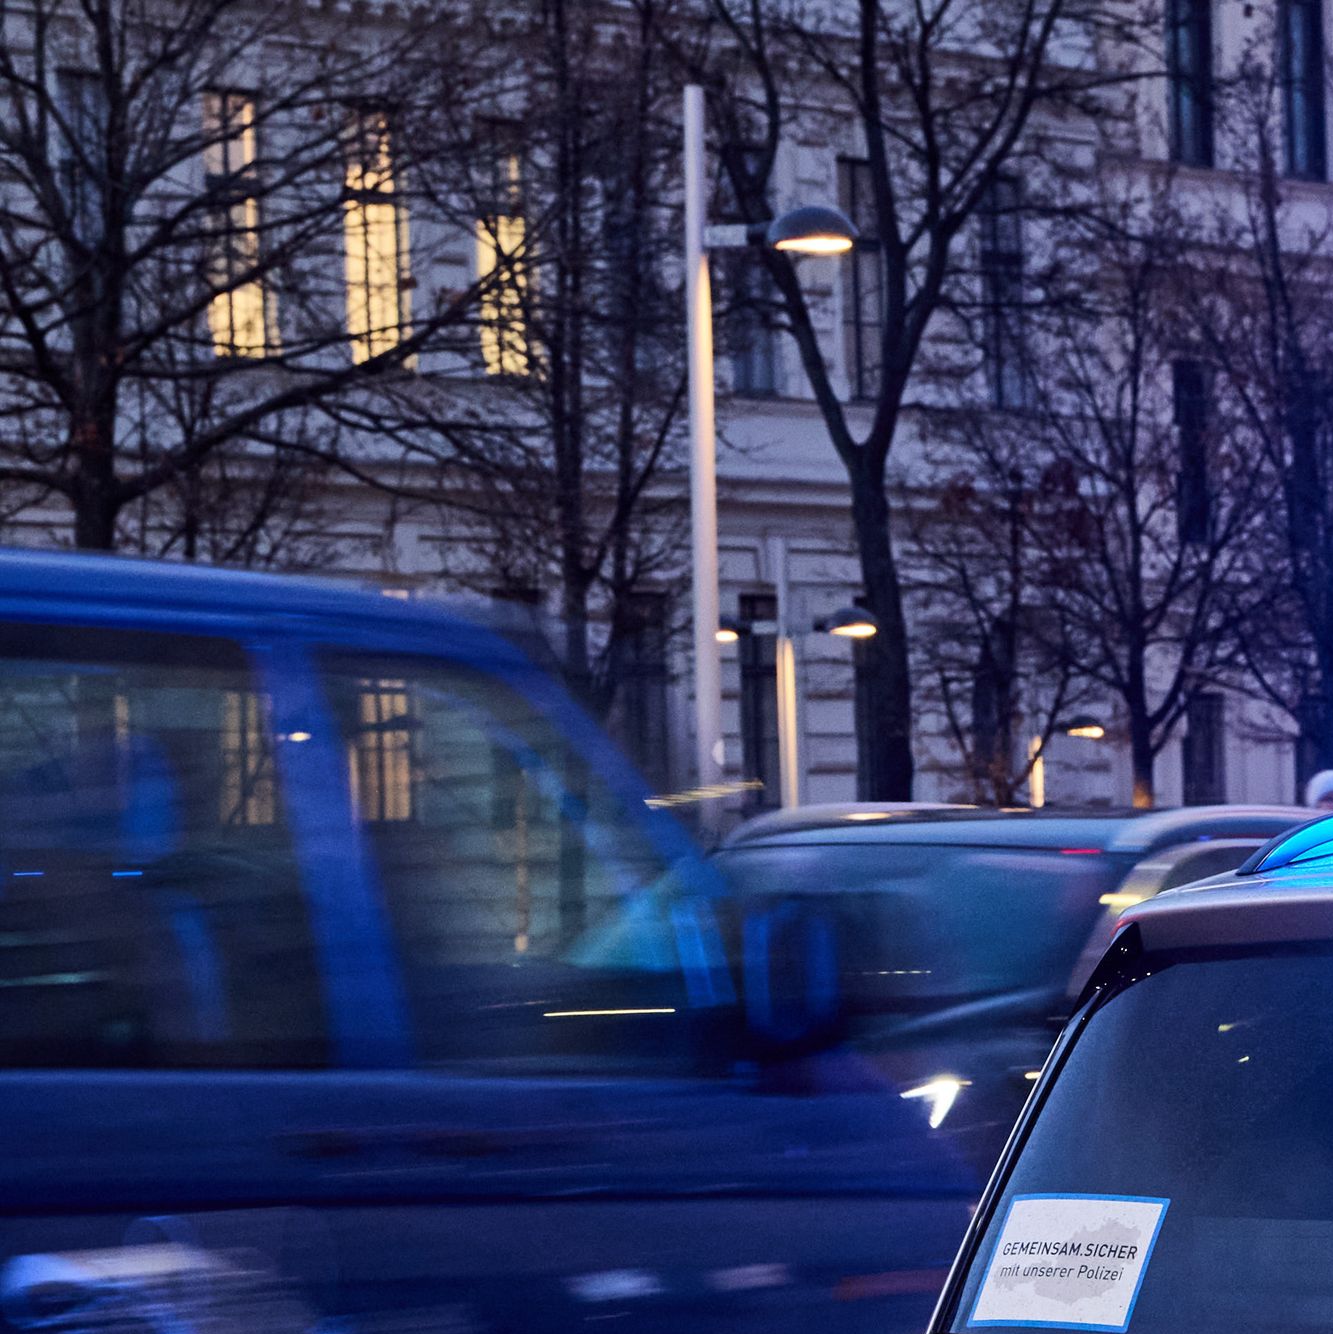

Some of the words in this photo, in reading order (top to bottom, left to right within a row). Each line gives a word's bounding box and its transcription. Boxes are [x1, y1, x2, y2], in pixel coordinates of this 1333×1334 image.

[1002, 1241, 1138, 1260] GEMEINSAM.SICHER
[1000, 1264, 1020, 1277] mit
[1023, 1266, 1074, 1279] unserer
[1077, 1265, 1125, 1281] Polizei
